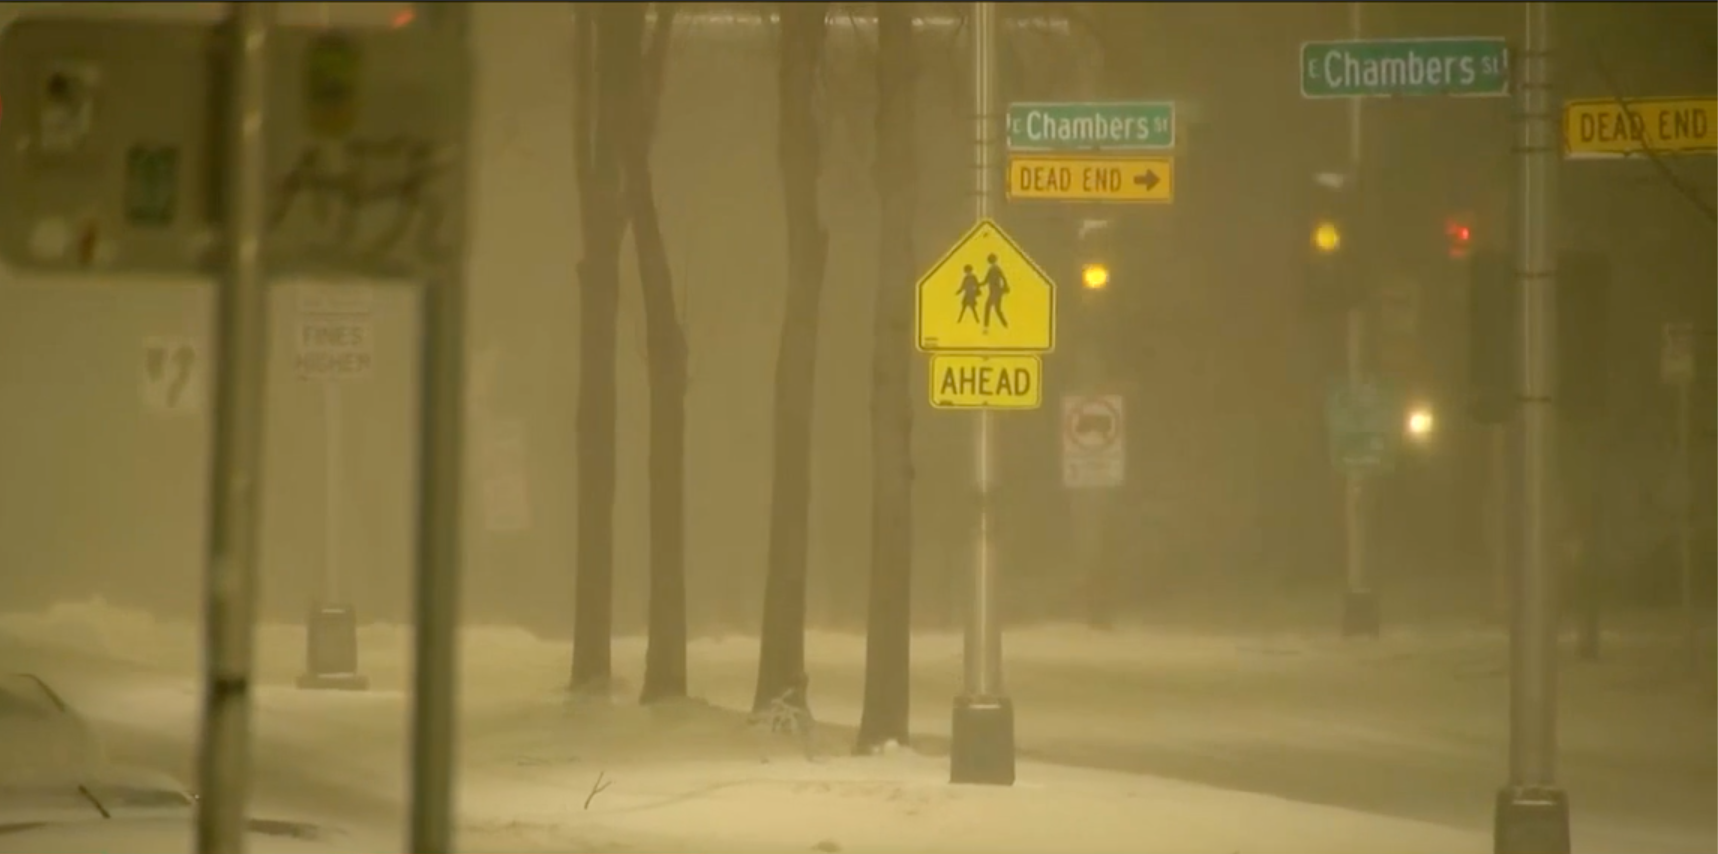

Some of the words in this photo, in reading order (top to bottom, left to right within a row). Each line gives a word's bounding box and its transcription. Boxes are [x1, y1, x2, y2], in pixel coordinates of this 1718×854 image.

[1309, 58, 1320, 78] E
[1324, 50, 1475, 88] Chambers
[1481, 56, 1499, 74] St
[1026, 110, 1149, 140] Chambers
[1154, 117, 1168, 132] St
[1580, 112, 1644, 143] DEAD
[1658, 109, 1708, 140] END
[1020, 167, 1071, 192] DEAD
[1083, 167, 1122, 192] END
[302, 326, 363, 347] FINES
[940, 366, 1031, 396] AHEAD
